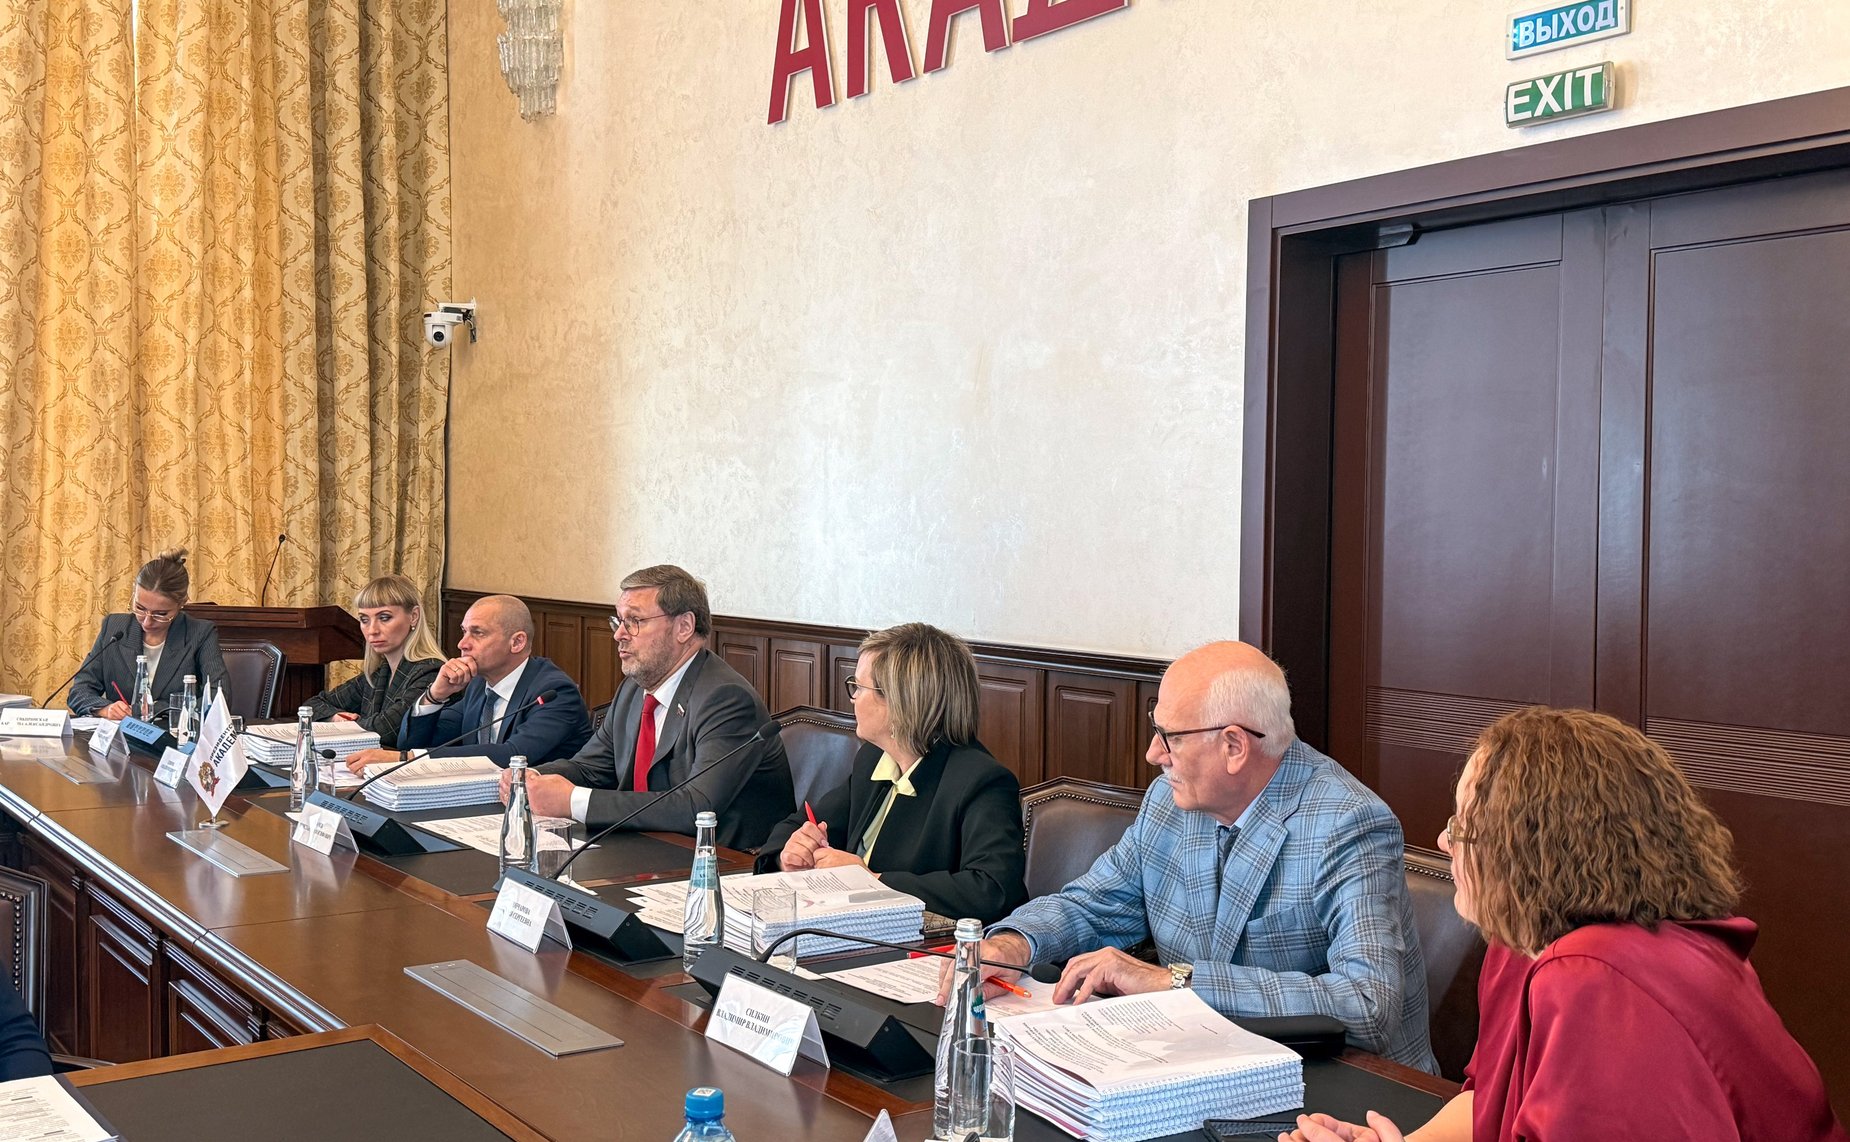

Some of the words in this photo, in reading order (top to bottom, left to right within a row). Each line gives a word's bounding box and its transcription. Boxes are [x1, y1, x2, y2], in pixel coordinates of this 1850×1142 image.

[1518, 1, 1615, 48] ВЫХОД
[1507, 65, 1603, 123] EXIT
[716, 1008, 747, 1029] ВЛАДИМИР
[745, 1007, 771, 1024] СИЛКИН
